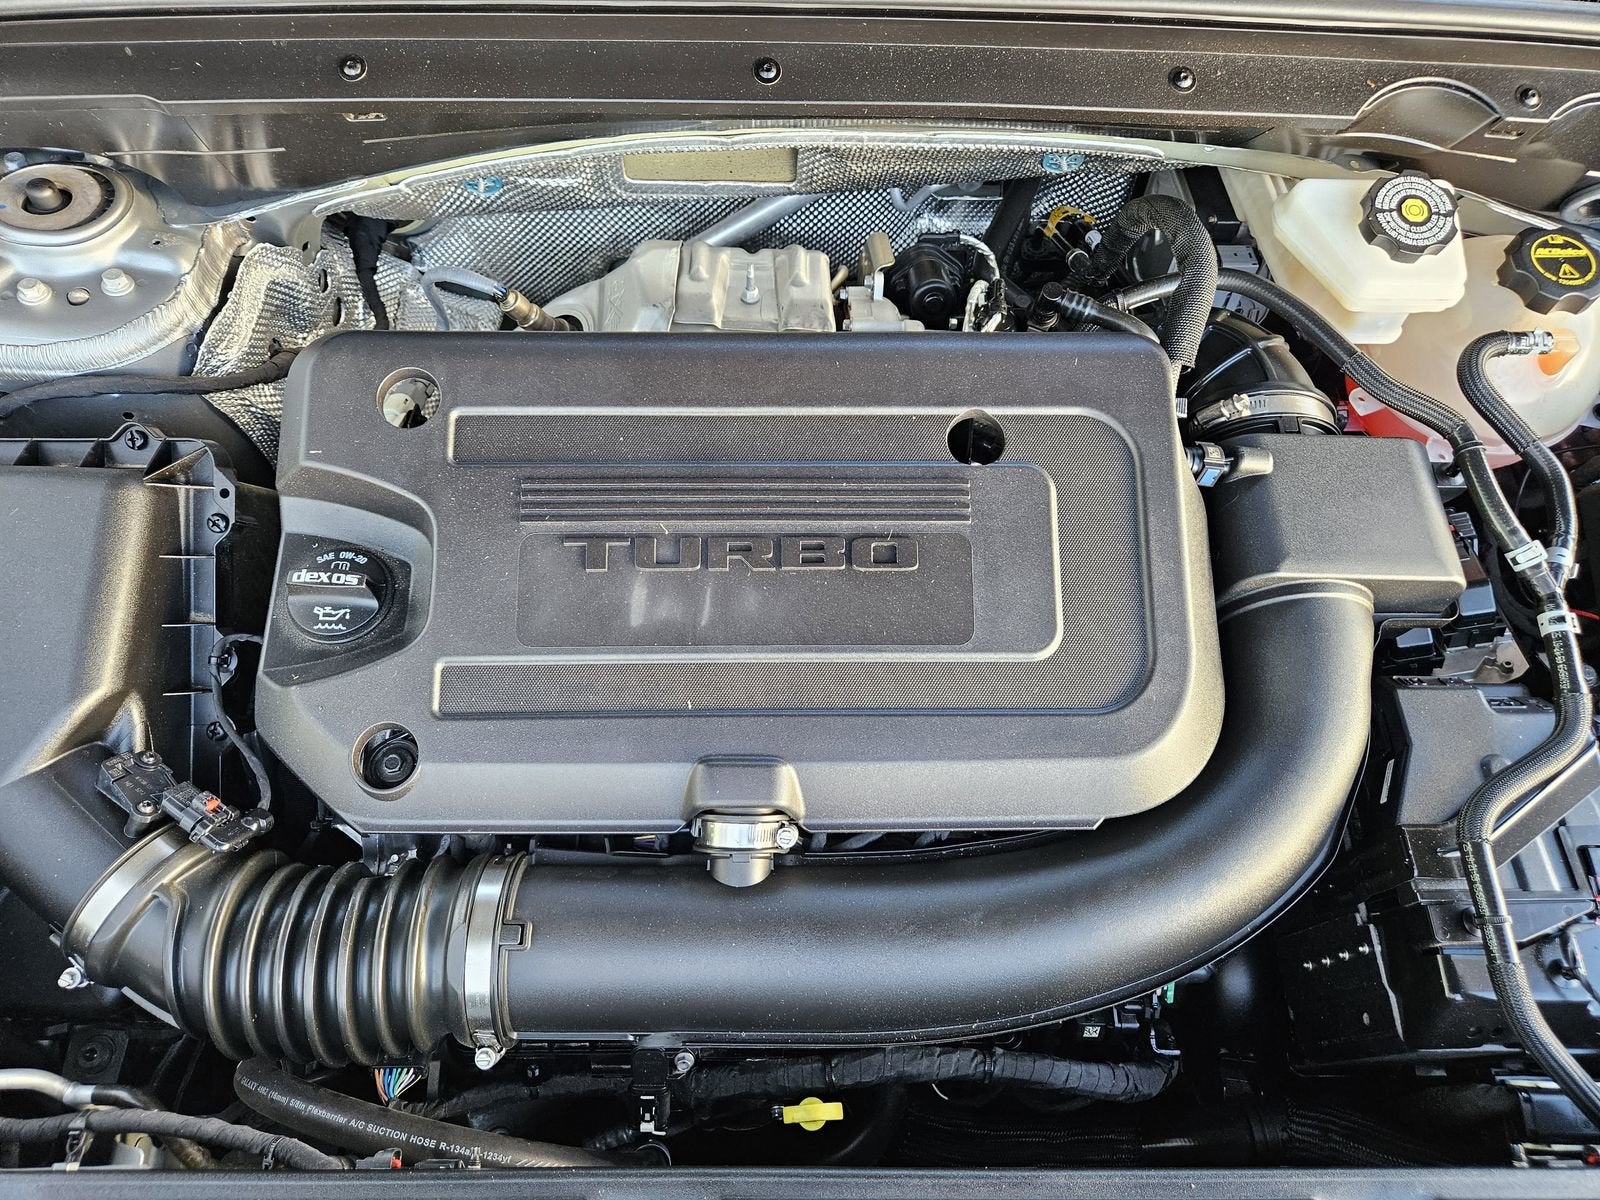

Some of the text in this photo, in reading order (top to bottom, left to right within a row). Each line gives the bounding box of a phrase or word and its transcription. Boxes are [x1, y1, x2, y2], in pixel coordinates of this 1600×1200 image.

[316, 551, 368, 565] SAE 0W-20
[562, 535, 919, 573] TURBO
[291, 568, 362, 586] dexos
[306, 1105, 348, 1124] Flexbarrier
[349, 1119, 366, 1130] A/C
[366, 1123, 408, 1142] SUCTION
[409, 1134, 437, 1149] HOSE
